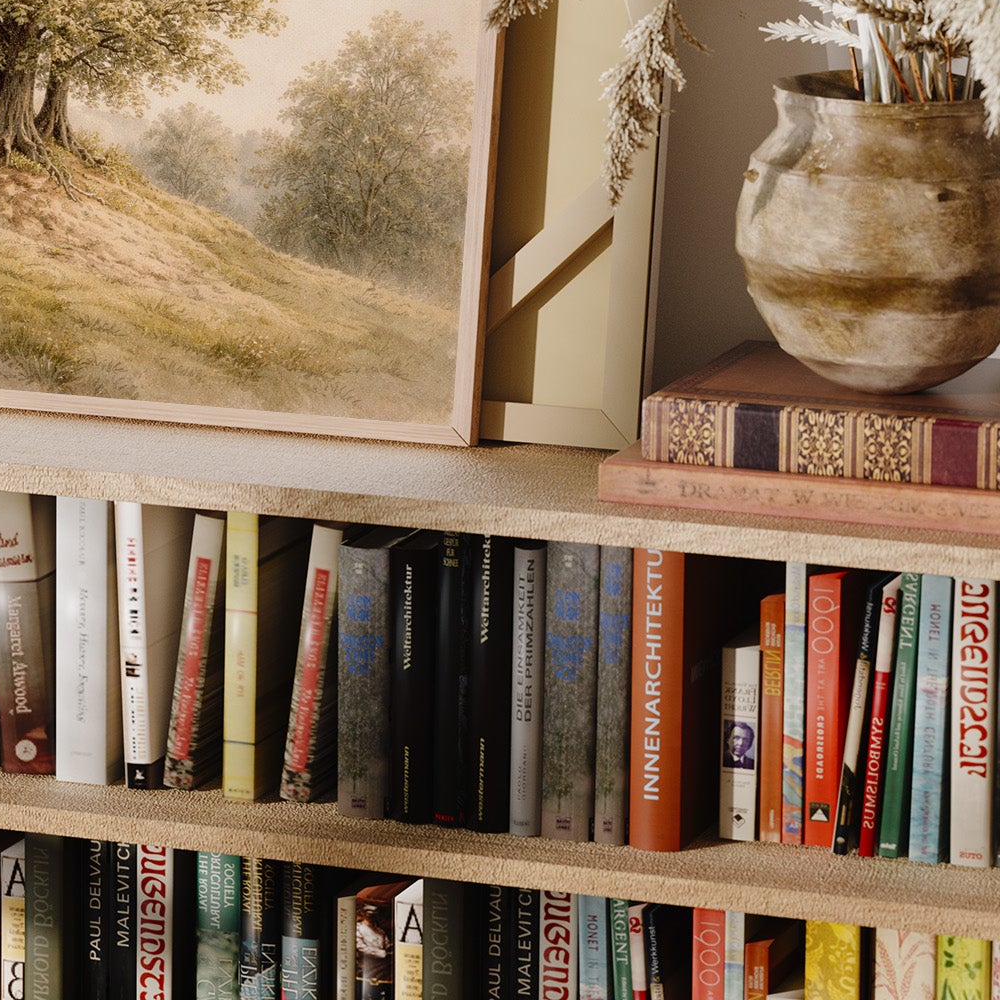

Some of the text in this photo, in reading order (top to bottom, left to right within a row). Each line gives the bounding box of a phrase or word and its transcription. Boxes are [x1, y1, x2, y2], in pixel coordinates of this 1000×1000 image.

[6, 595, 32, 715] Margaret Atwood
[402, 563, 414, 670] Weltarchitektur
[516, 574, 526, 687] EINSAMKEIT
[524, 559, 536, 723] DER PRIMZAHLEN
[477, 737, 486, 821] westermann
[89, 839, 102, 962] PAUL DELVAU
[488, 885, 502, 958] DELVAU
[587, 914, 600, 952] MONET
[629, 917, 641, 934] 2
[648, 925, 660, 975] Werkkunst
[693, 920, 721, 986] 1900
